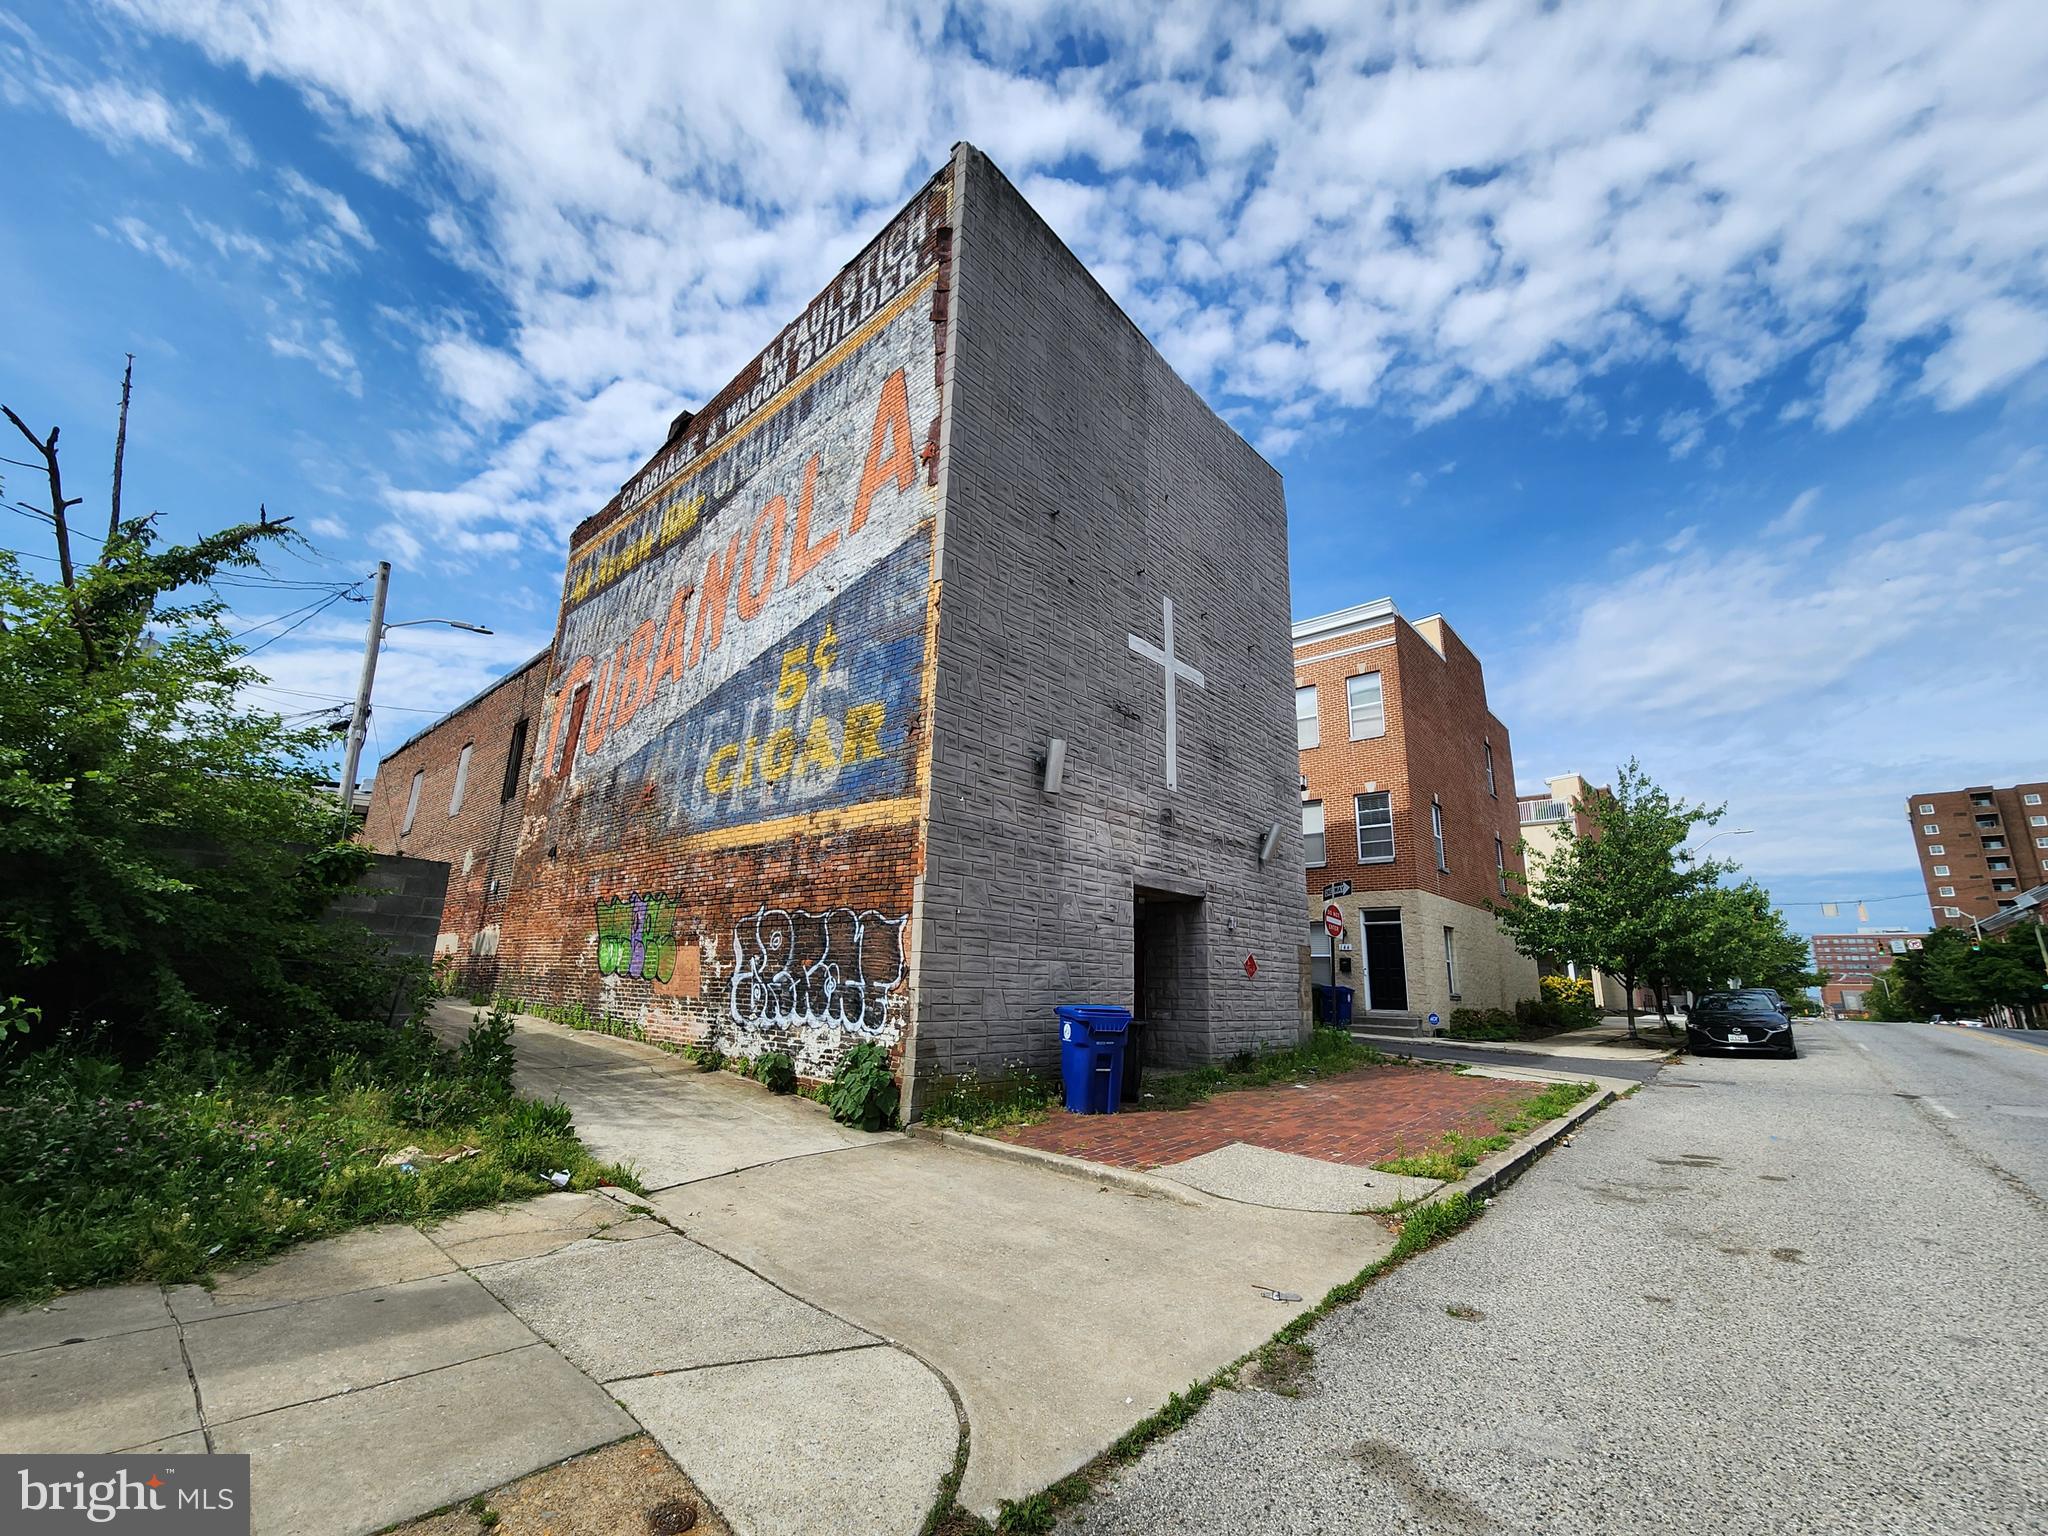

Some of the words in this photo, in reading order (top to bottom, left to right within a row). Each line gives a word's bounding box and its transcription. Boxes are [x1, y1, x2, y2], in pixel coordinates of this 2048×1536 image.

[620, 433, 699, 512] CARRIAGE
[725, 358, 789, 431] WAGON
[704, 699, 888, 795] CIGAR
